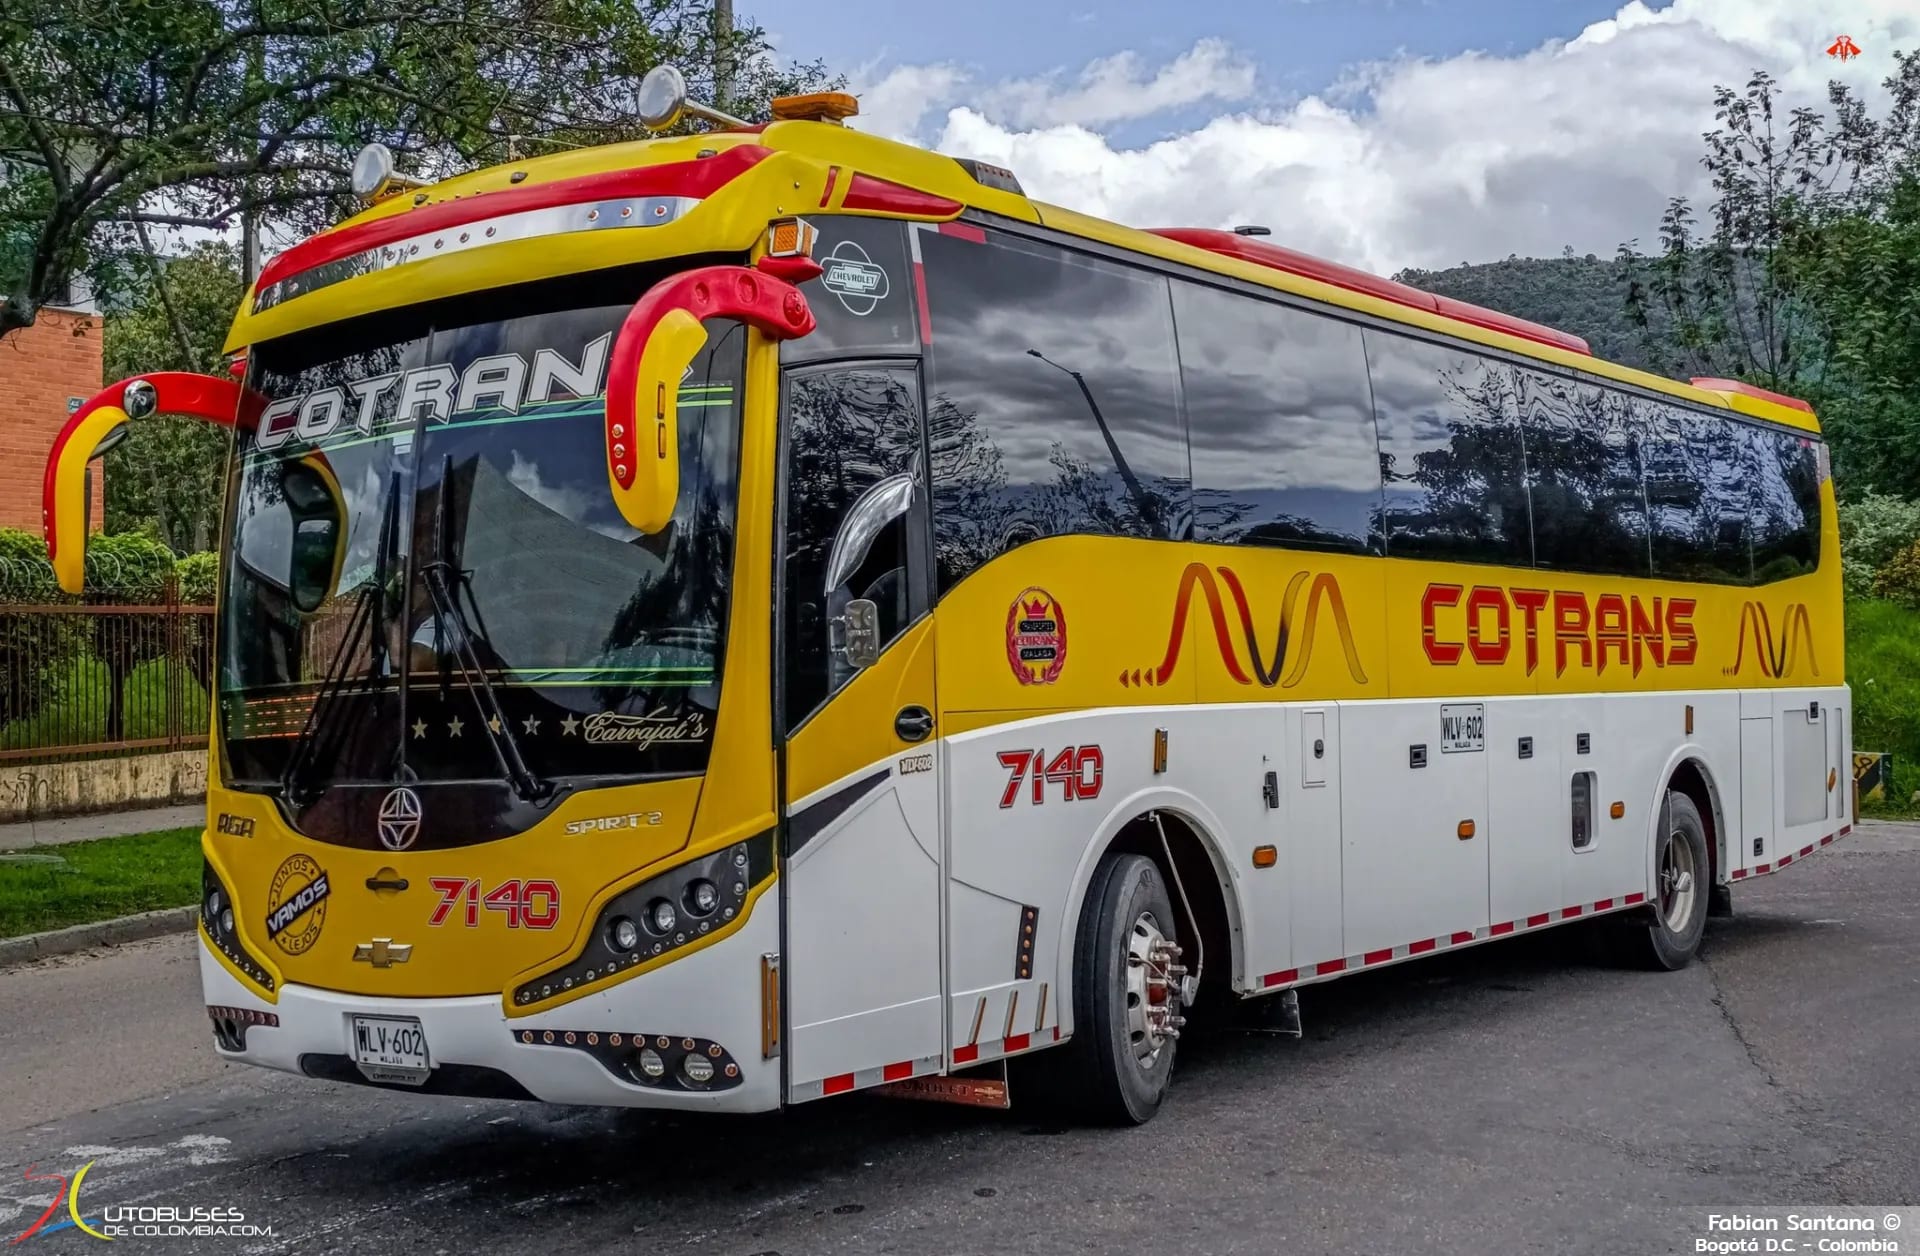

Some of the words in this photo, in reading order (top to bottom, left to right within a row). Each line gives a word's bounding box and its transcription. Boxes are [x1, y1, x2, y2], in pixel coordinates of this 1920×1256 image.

[832, 270, 875, 284] CHEVROLET
[254, 331, 694, 452] COTRAN
[1421, 583, 1698, 679] COTRANS
[583, 705, 709, 751] Carvajal's
[997, 744, 1104, 809] 7140
[566, 813, 642, 836] SPIRIT
[647, 810, 664, 826] 2
[273, 858, 309, 894] JUNTOS
[267, 875, 328, 932] VAMOS
[428, 877, 560, 930] 7140
[288, 924, 319, 950] LEJOS
